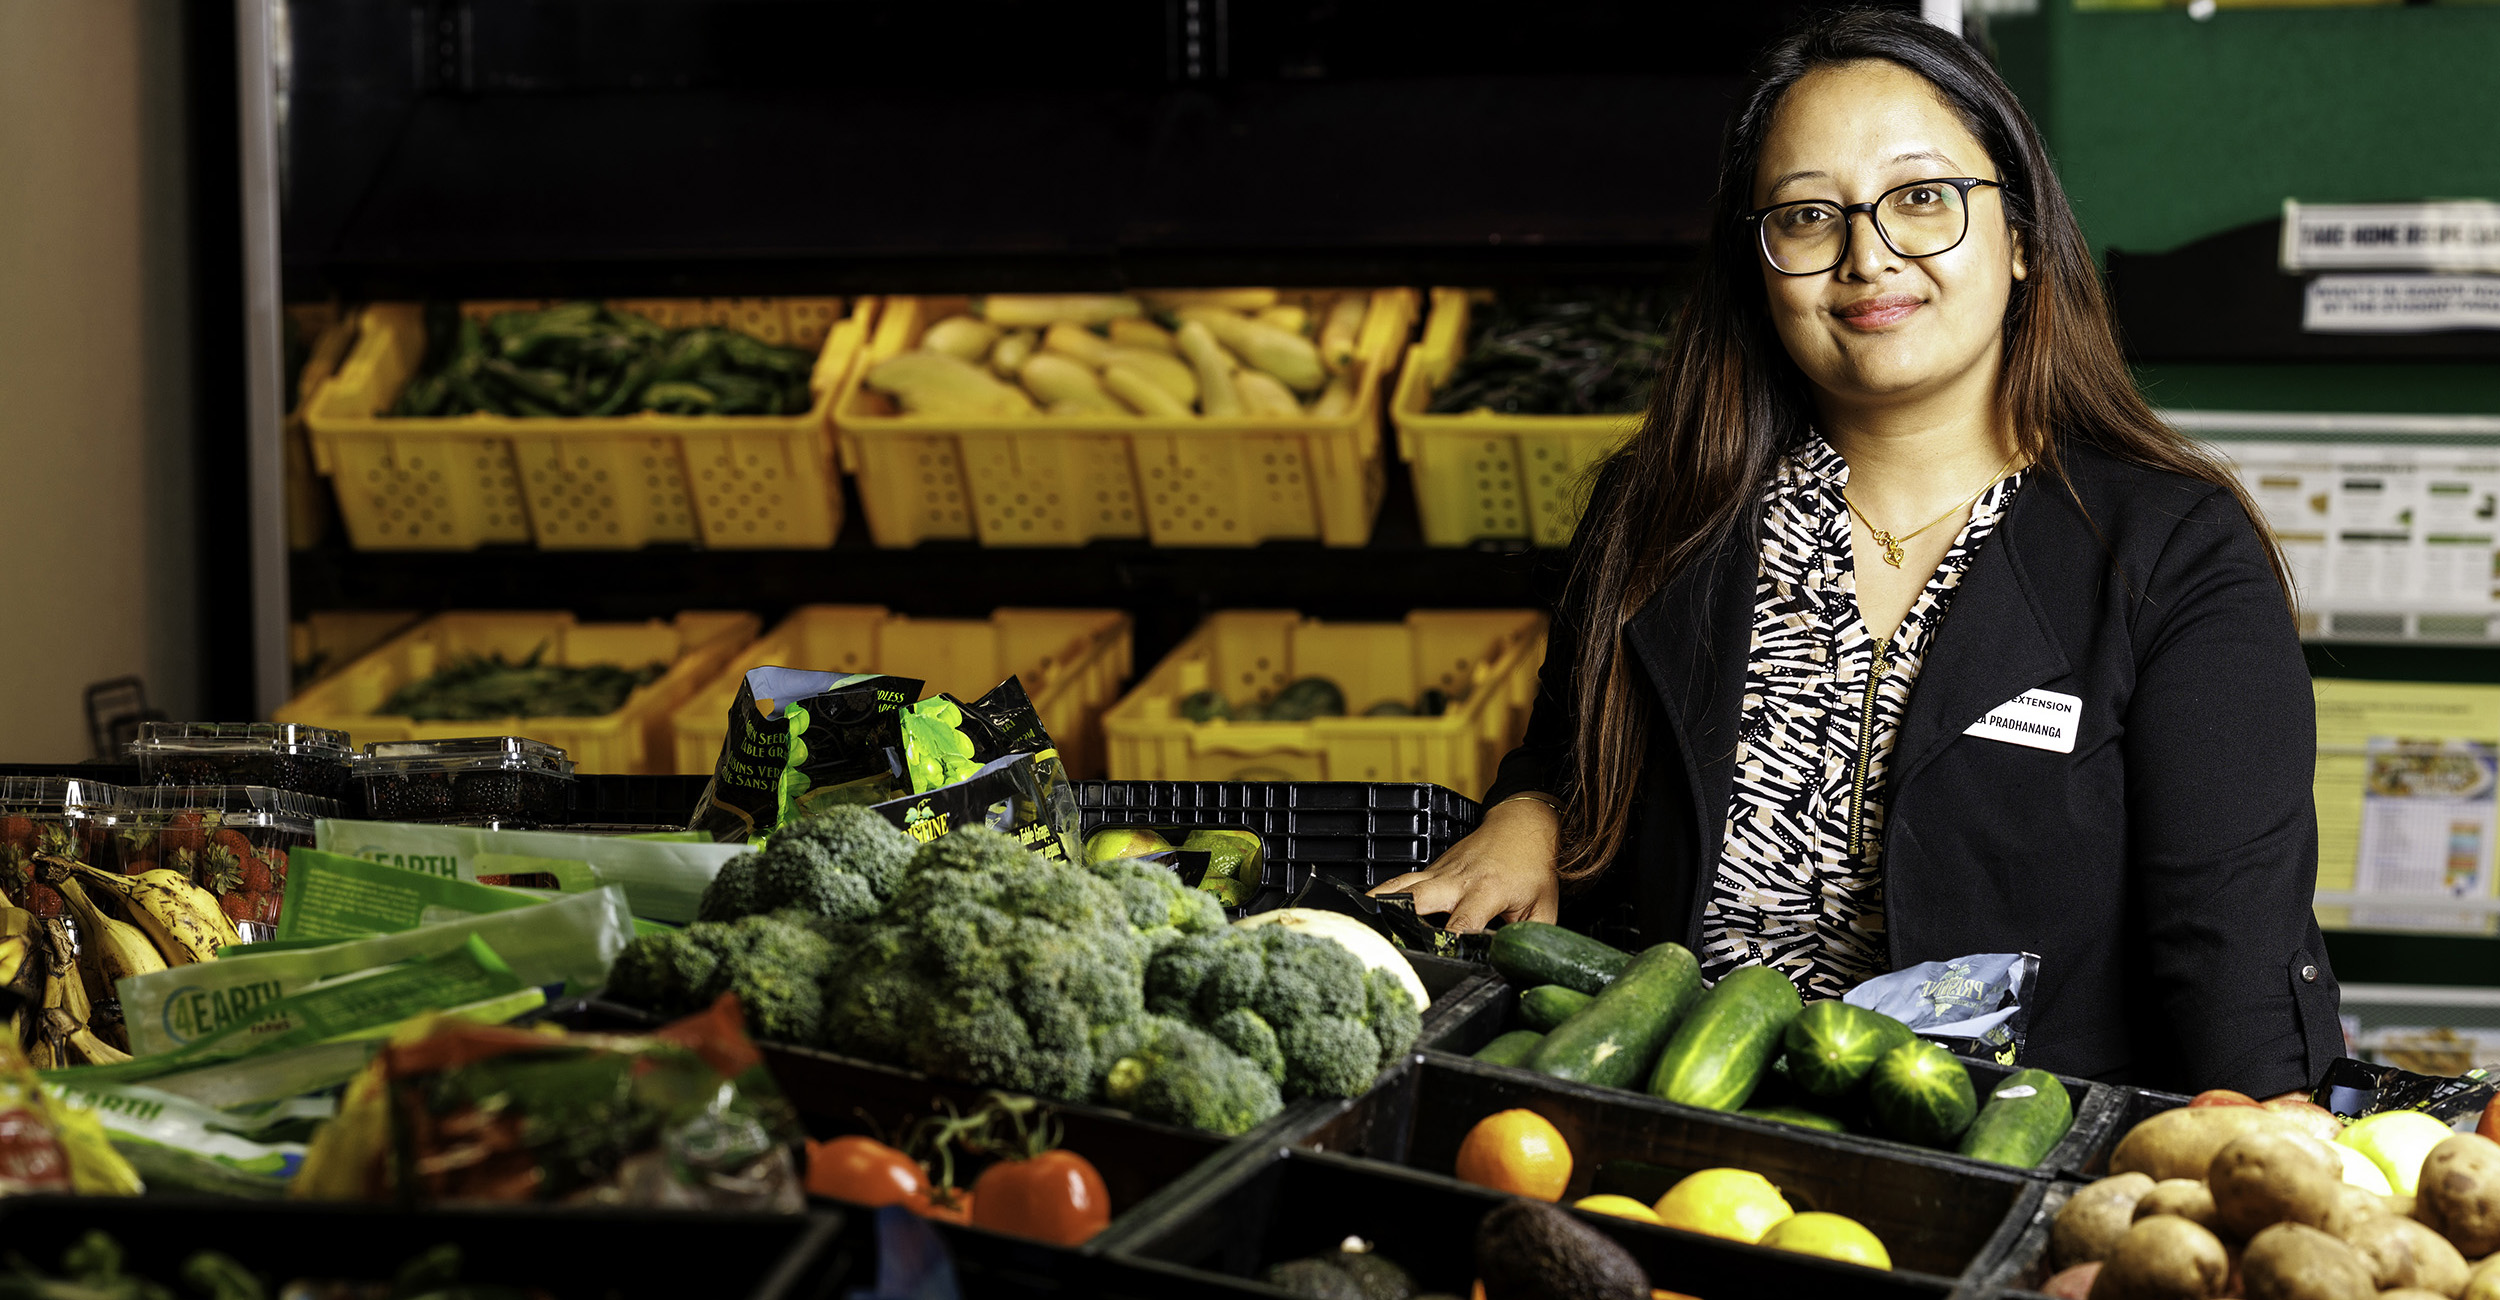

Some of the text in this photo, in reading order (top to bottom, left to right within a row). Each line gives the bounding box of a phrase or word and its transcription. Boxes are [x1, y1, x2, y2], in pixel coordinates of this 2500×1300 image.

[2011, 695, 2072, 713] EXTENSION
[1989, 714, 2062, 739] PRADHANANGA
[736, 775, 768, 791] SANS
